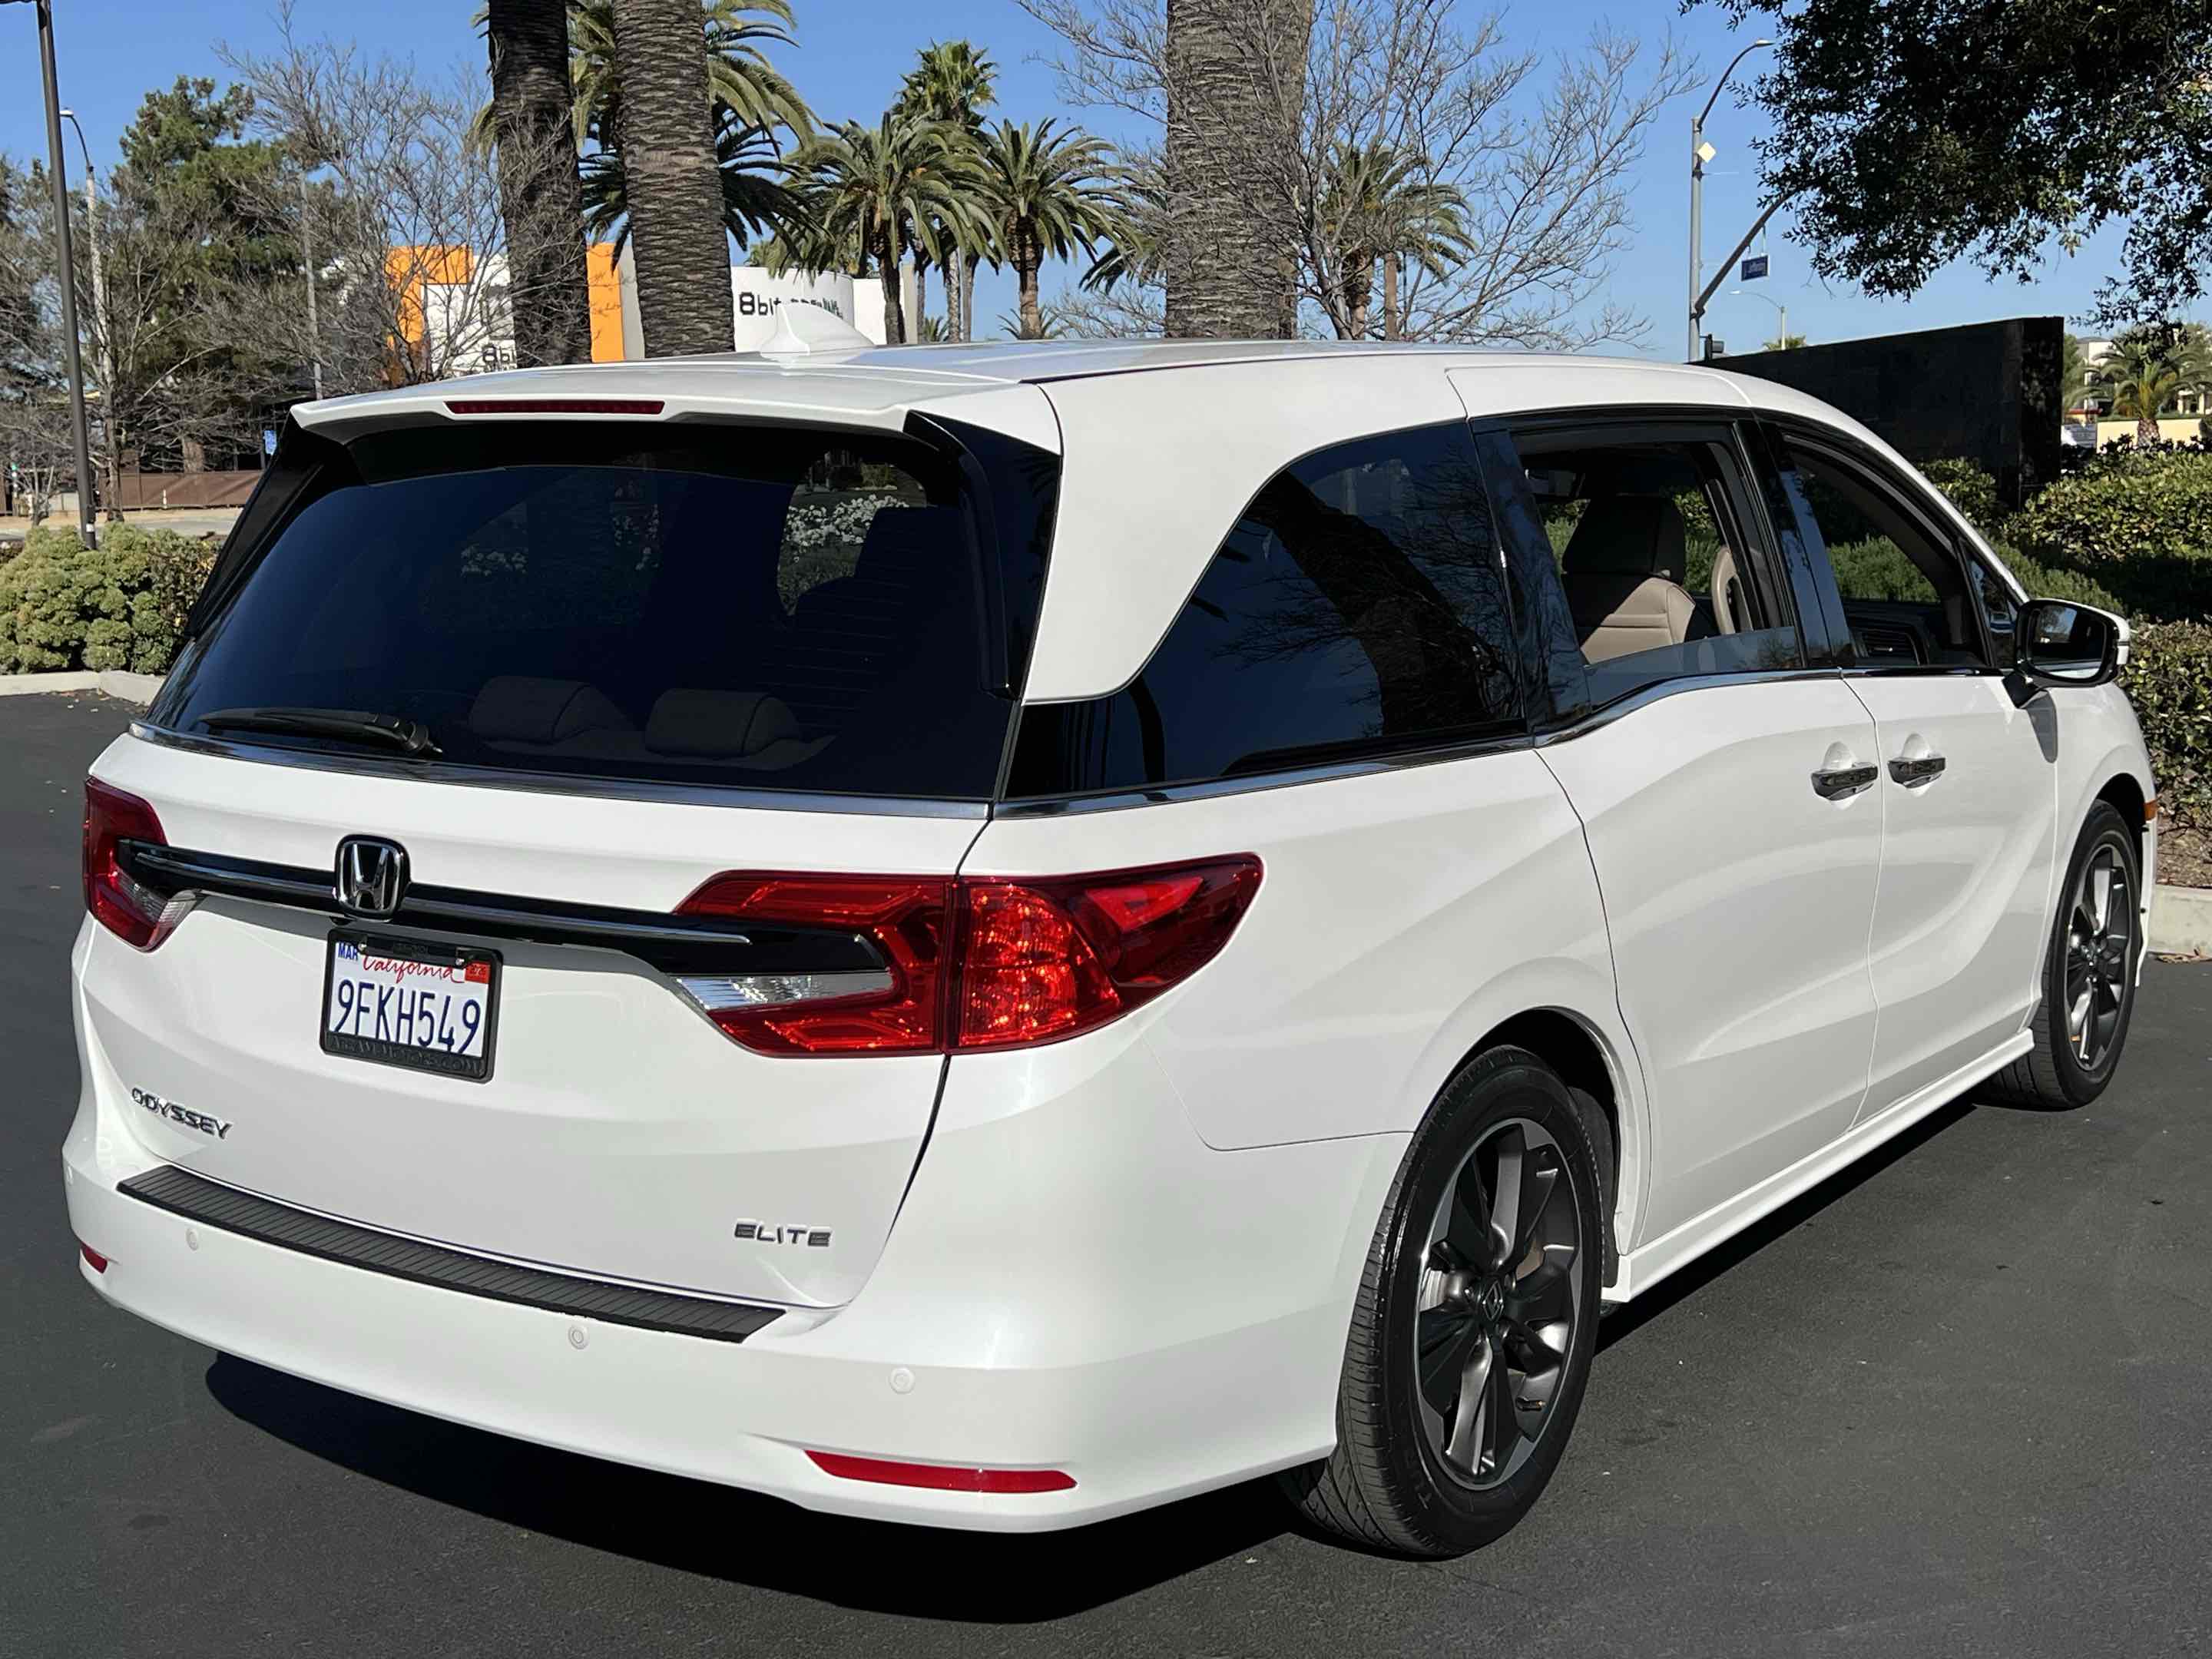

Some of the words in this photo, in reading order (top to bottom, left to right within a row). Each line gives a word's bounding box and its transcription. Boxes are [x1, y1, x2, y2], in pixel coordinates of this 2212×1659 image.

[338, 941, 358, 961] MAR
[363, 955, 465, 983] California
[334, 979, 481, 1055] 9FKH549
[131, 1087, 233, 1140] ODYSSEY
[734, 1223, 832, 1247] ELITE
